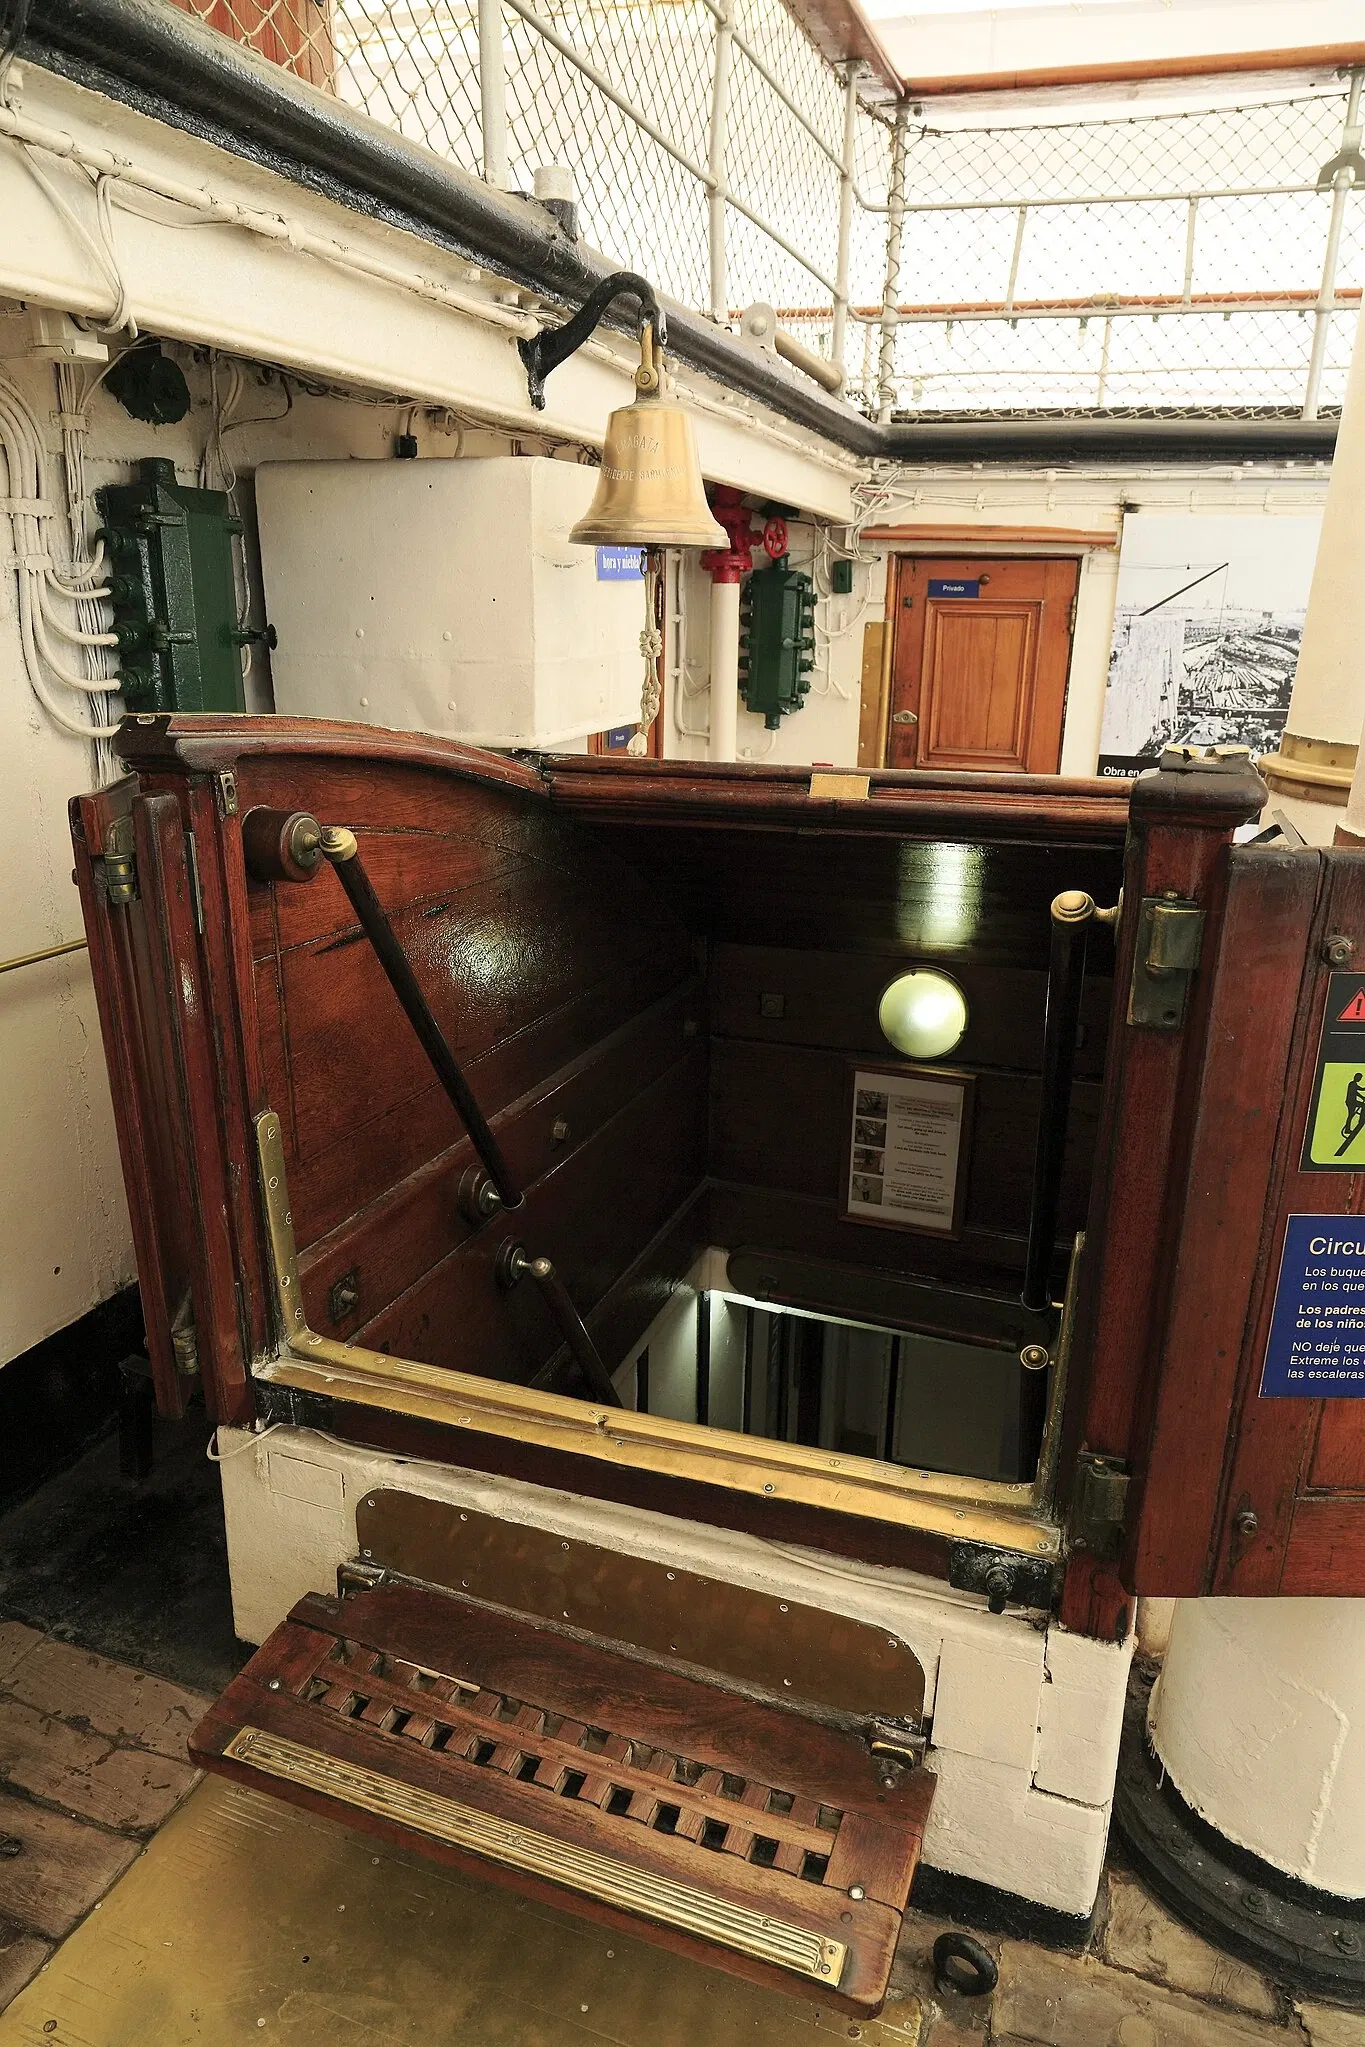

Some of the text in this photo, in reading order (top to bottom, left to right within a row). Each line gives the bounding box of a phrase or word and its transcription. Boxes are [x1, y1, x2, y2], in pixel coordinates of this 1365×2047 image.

[942, 584, 965, 592] Privado
[1103, 766, 1126, 776] Obra
[1305, 1266, 1327, 1277] Los
[1302, 1281, 1365, 1293] en los que
[1298, 1304, 1365, 1317] Los padres
[1296, 1318, 1312, 1328] de
[1314, 1319, 1334, 1328] los
[1292, 1341, 1365, 1354] NO deje que
[1290, 1355, 1339, 1366] Extreme
[1342, 1356, 1360, 1366] los
[1287, 1368, 1365, 1379] las escaleras
